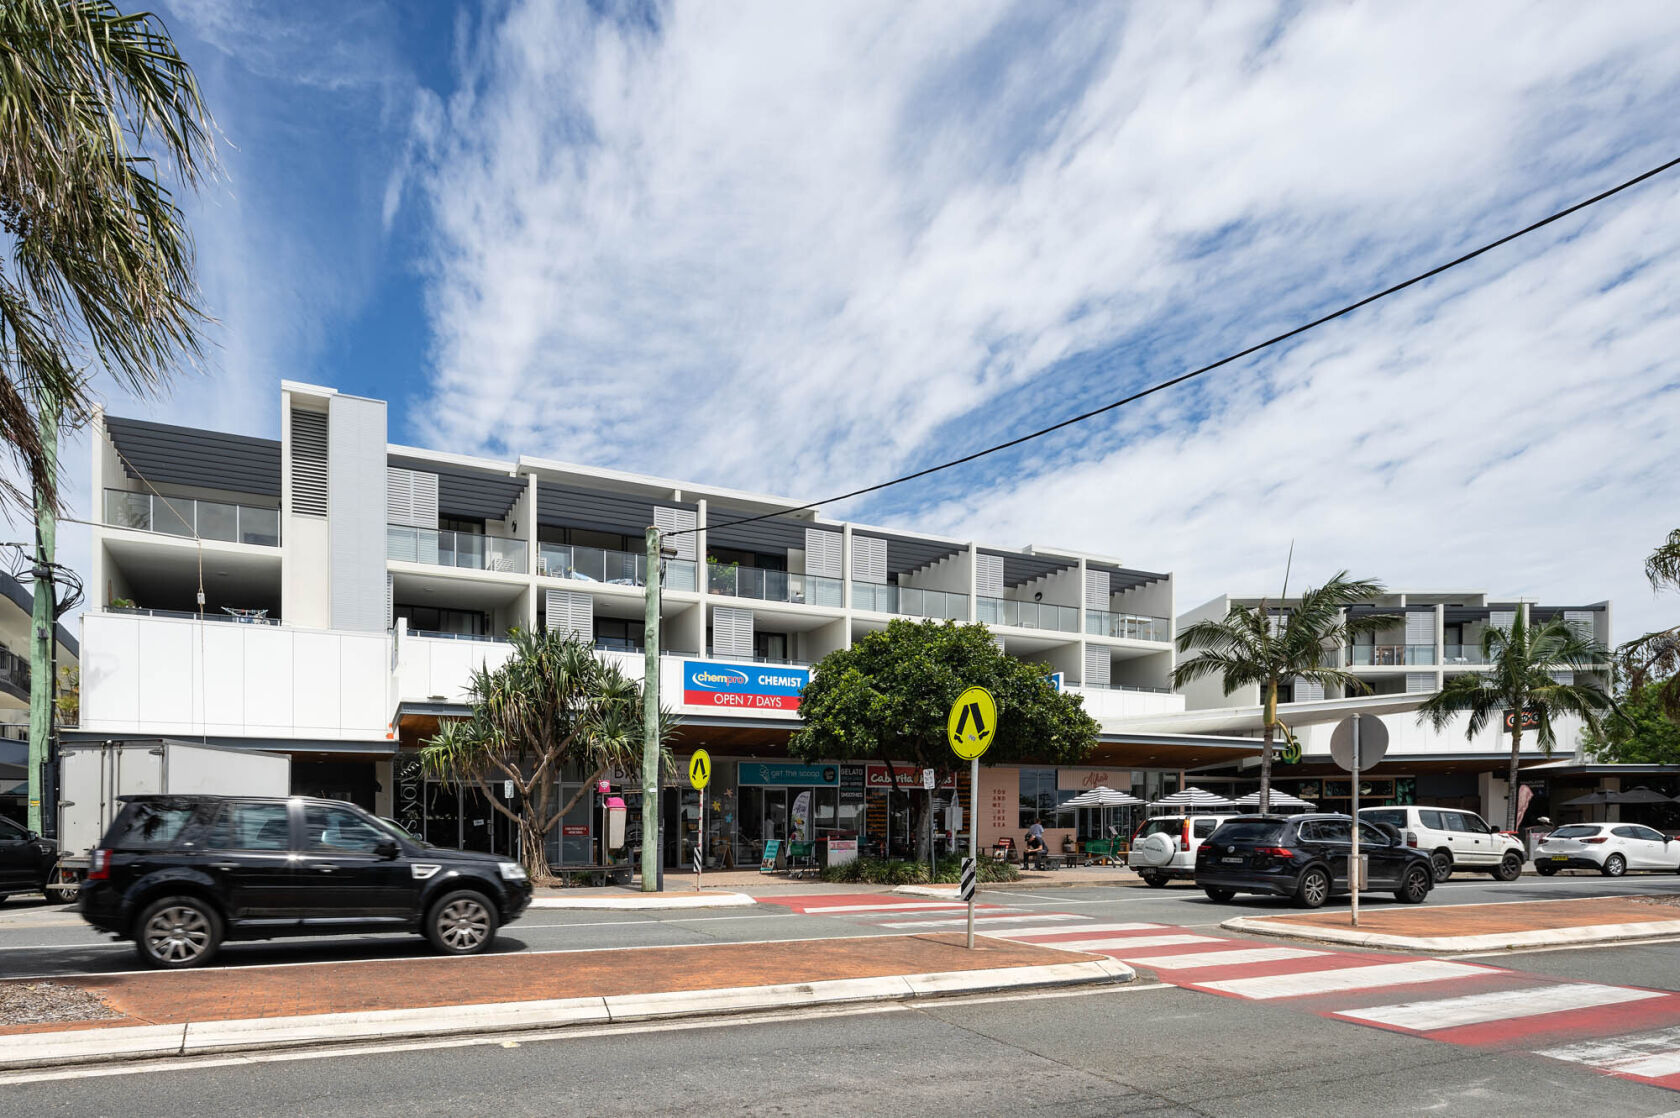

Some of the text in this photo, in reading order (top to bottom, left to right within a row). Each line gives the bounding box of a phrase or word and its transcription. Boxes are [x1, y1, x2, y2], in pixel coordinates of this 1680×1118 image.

[697, 671, 802, 688] chempro CHEMIST
[713, 693, 782, 708] OPEN 7 DAYS
[840, 768, 863, 776] GELATO
[870, 770, 914, 783] Cabrita
